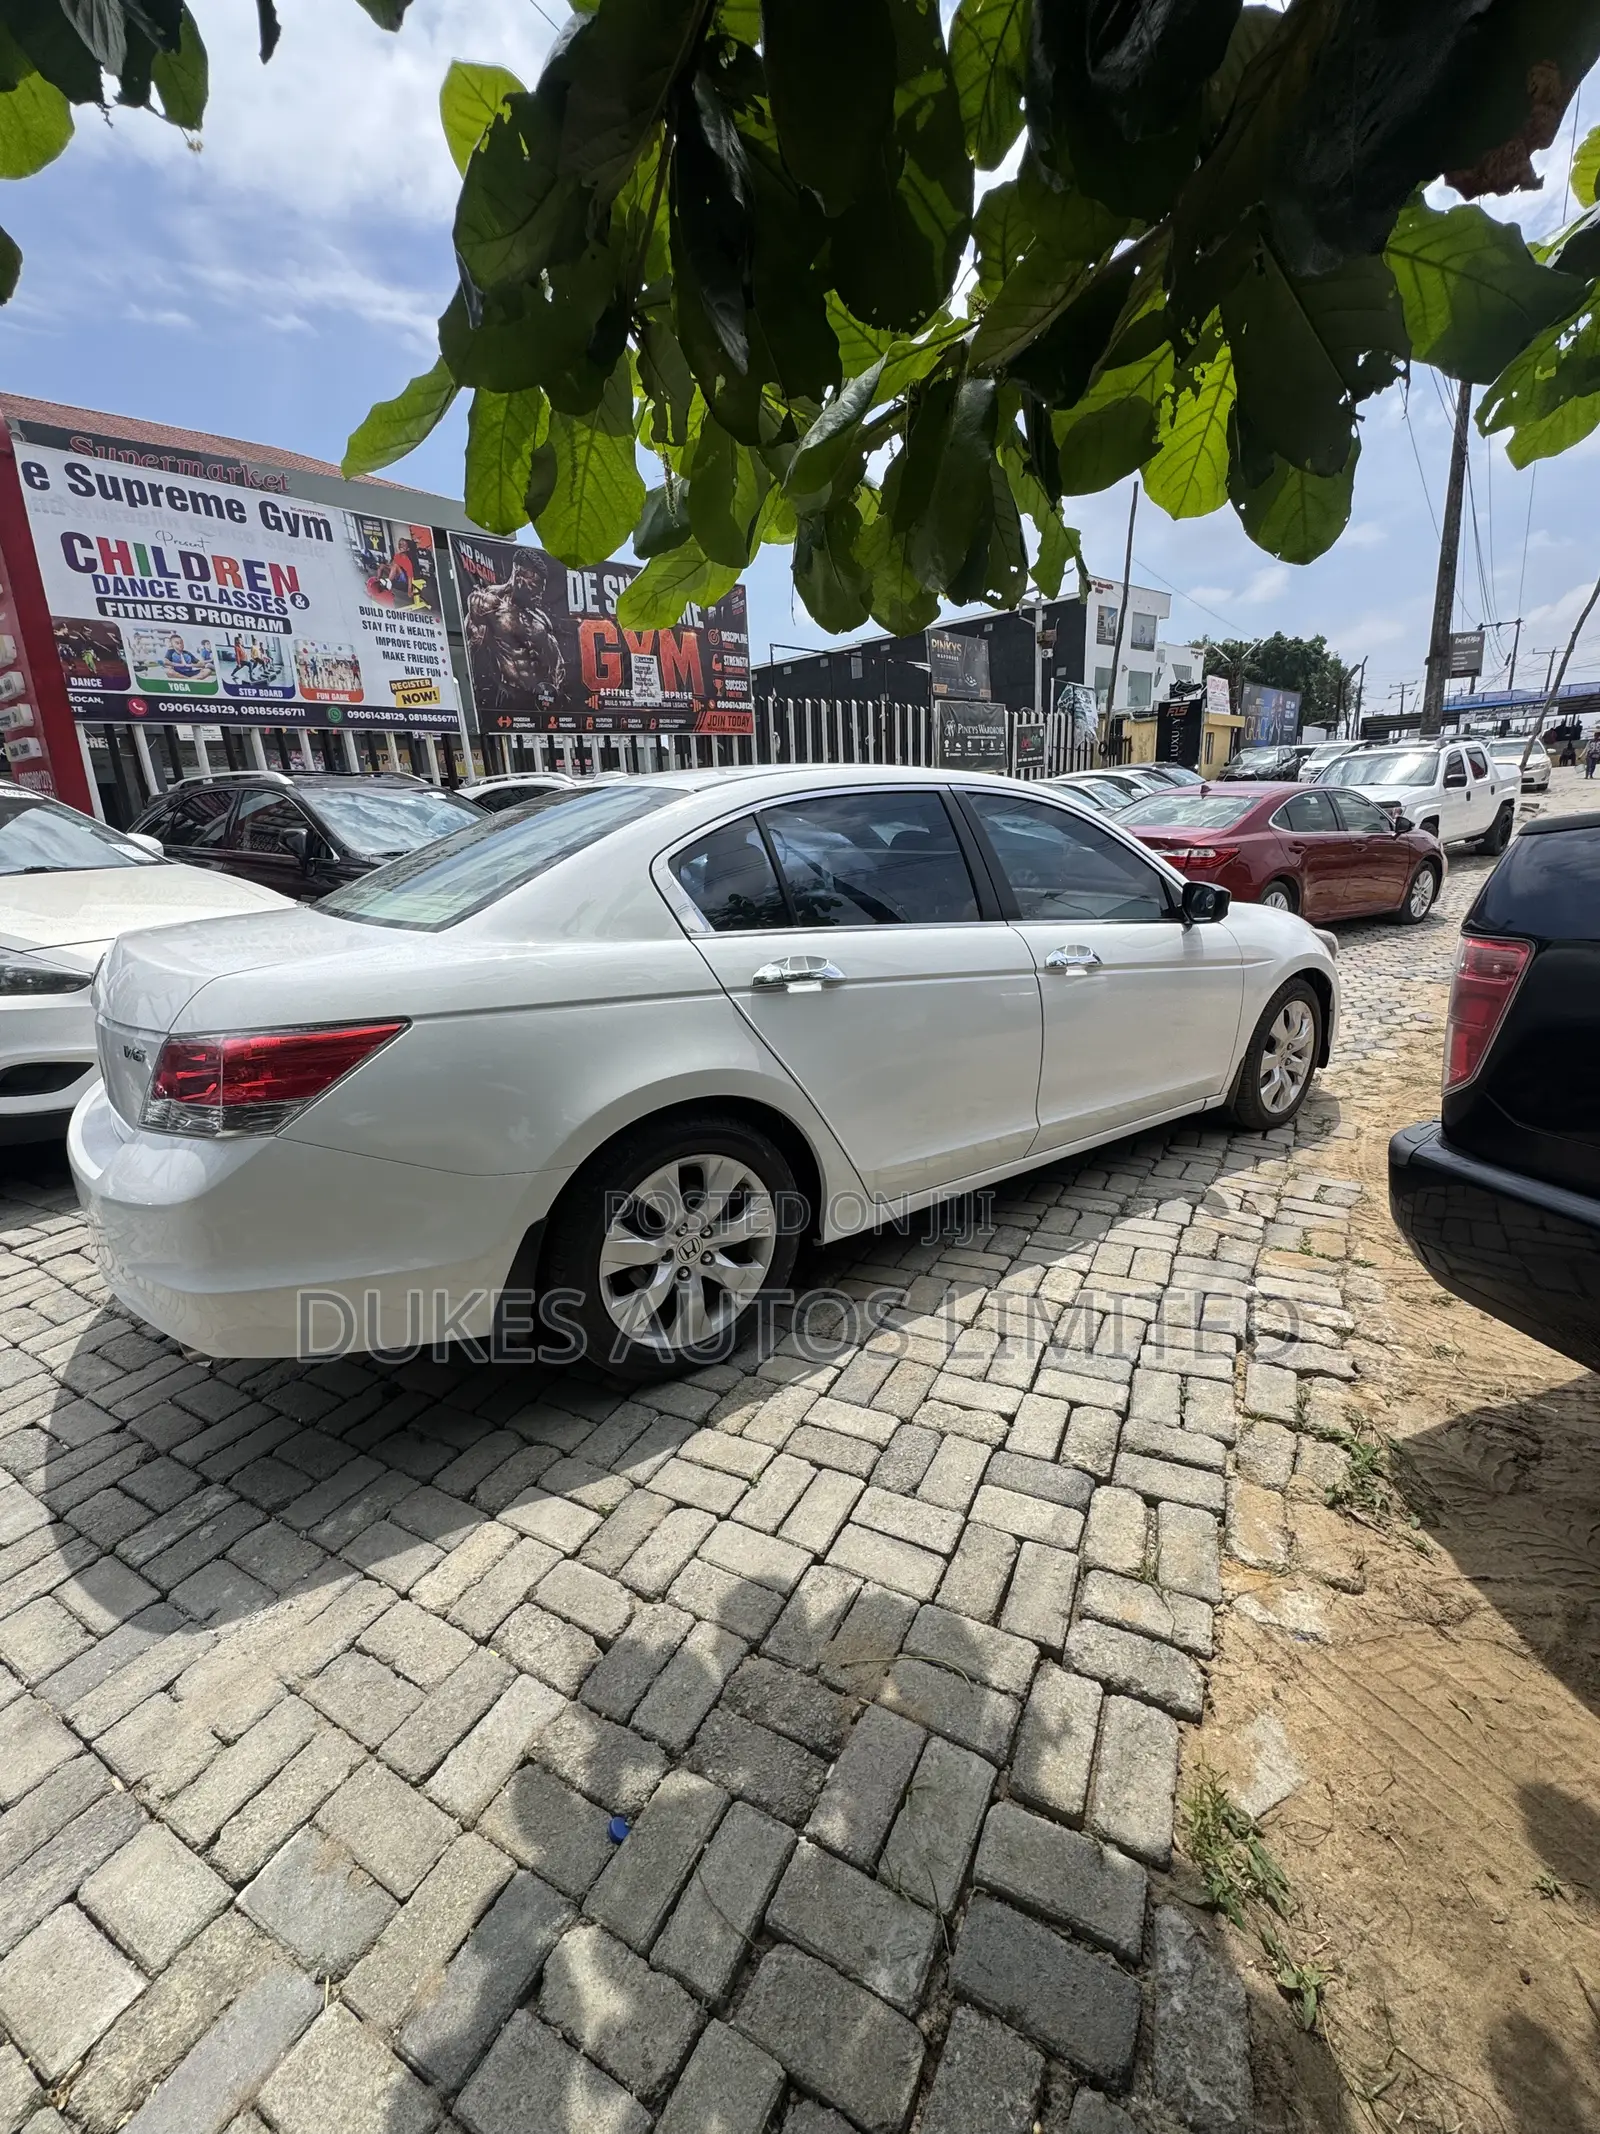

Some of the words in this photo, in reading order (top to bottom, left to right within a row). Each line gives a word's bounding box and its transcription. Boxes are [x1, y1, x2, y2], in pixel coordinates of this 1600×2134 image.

[70, 435, 291, 493] Supermarket
[64, 462, 247, 524] Supreme
[258, 500, 334, 543] Gym
[155, 530, 211, 553] Present
[60, 531, 301, 598] CHILDREN
[474, 548, 495, 572] PAIN
[91, 573, 181, 600] DANCE
[187, 583, 289, 616] CLASSES
[567, 569, 600, 614] DE
[104, 601, 190, 621] FITNESS
[194, 607, 285, 633] PROGRAM
[359, 605, 384, 618] BUILD
[386, 609, 434, 625] CONFIDENCE
[362, 620, 386, 632] STAY
[385, 624, 397, 634] FIT
[407, 627, 436, 638] HEALTH
[375, 636, 411, 649] IMPROVE
[413, 640, 438, 652] FOCUS
[382, 650, 406, 662] MAKE
[407, 653, 440, 666] FRIENDS
[578, 619, 706, 697] GYM
[404, 665, 425, 676] HAVE
[426, 668, 442, 678] FUN
[70, 677, 103, 688] DANCE
[168, 682, 191, 693] YOGA
[391, 679, 432, 691] REGISTER
[724, 679, 748, 692] SUCCESS
[238, 687, 258, 697] STEP
[258, 689, 284, 698] BOARD
[401, 690, 439, 705] NOW!
[158, 702, 239, 716] 09061438129,
[240, 706, 306, 717] 08185656711
[707, 714, 726, 727] JOIN
[728, 715, 751, 728] TODAY
[123, 1045, 147, 1063] V6
